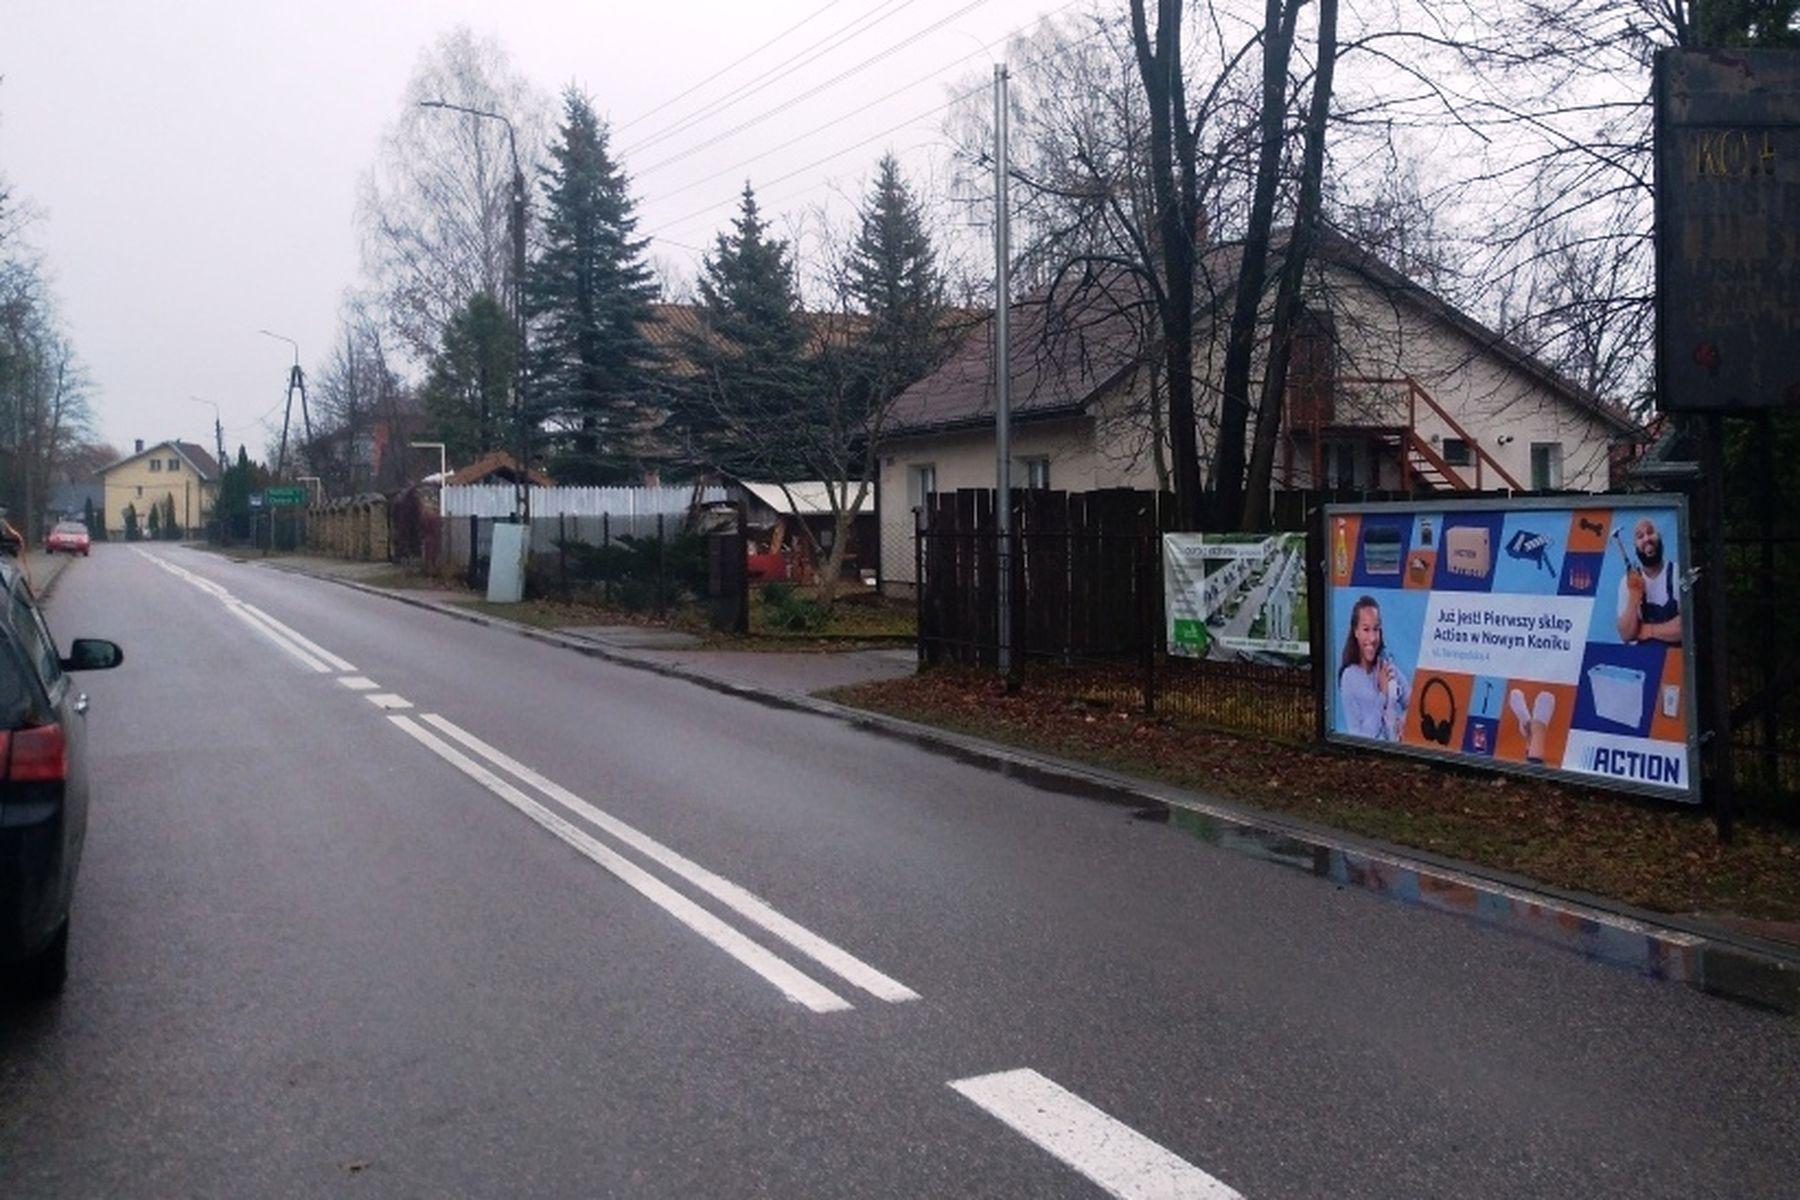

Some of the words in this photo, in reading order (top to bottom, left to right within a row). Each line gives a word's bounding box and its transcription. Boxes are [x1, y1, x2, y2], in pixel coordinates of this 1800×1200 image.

[1438, 609, 1456, 623] Już
[1484, 611, 1536, 630] Pierwszy
[1538, 613, 1573, 633] sklep
[1434, 628, 1468, 643] Action
[1470, 633, 1479, 643] w
[1482, 631, 1526, 650] Nowym
[1528, 634, 1571, 651] Koniku
[1594, 747, 1680, 784] ACTION
